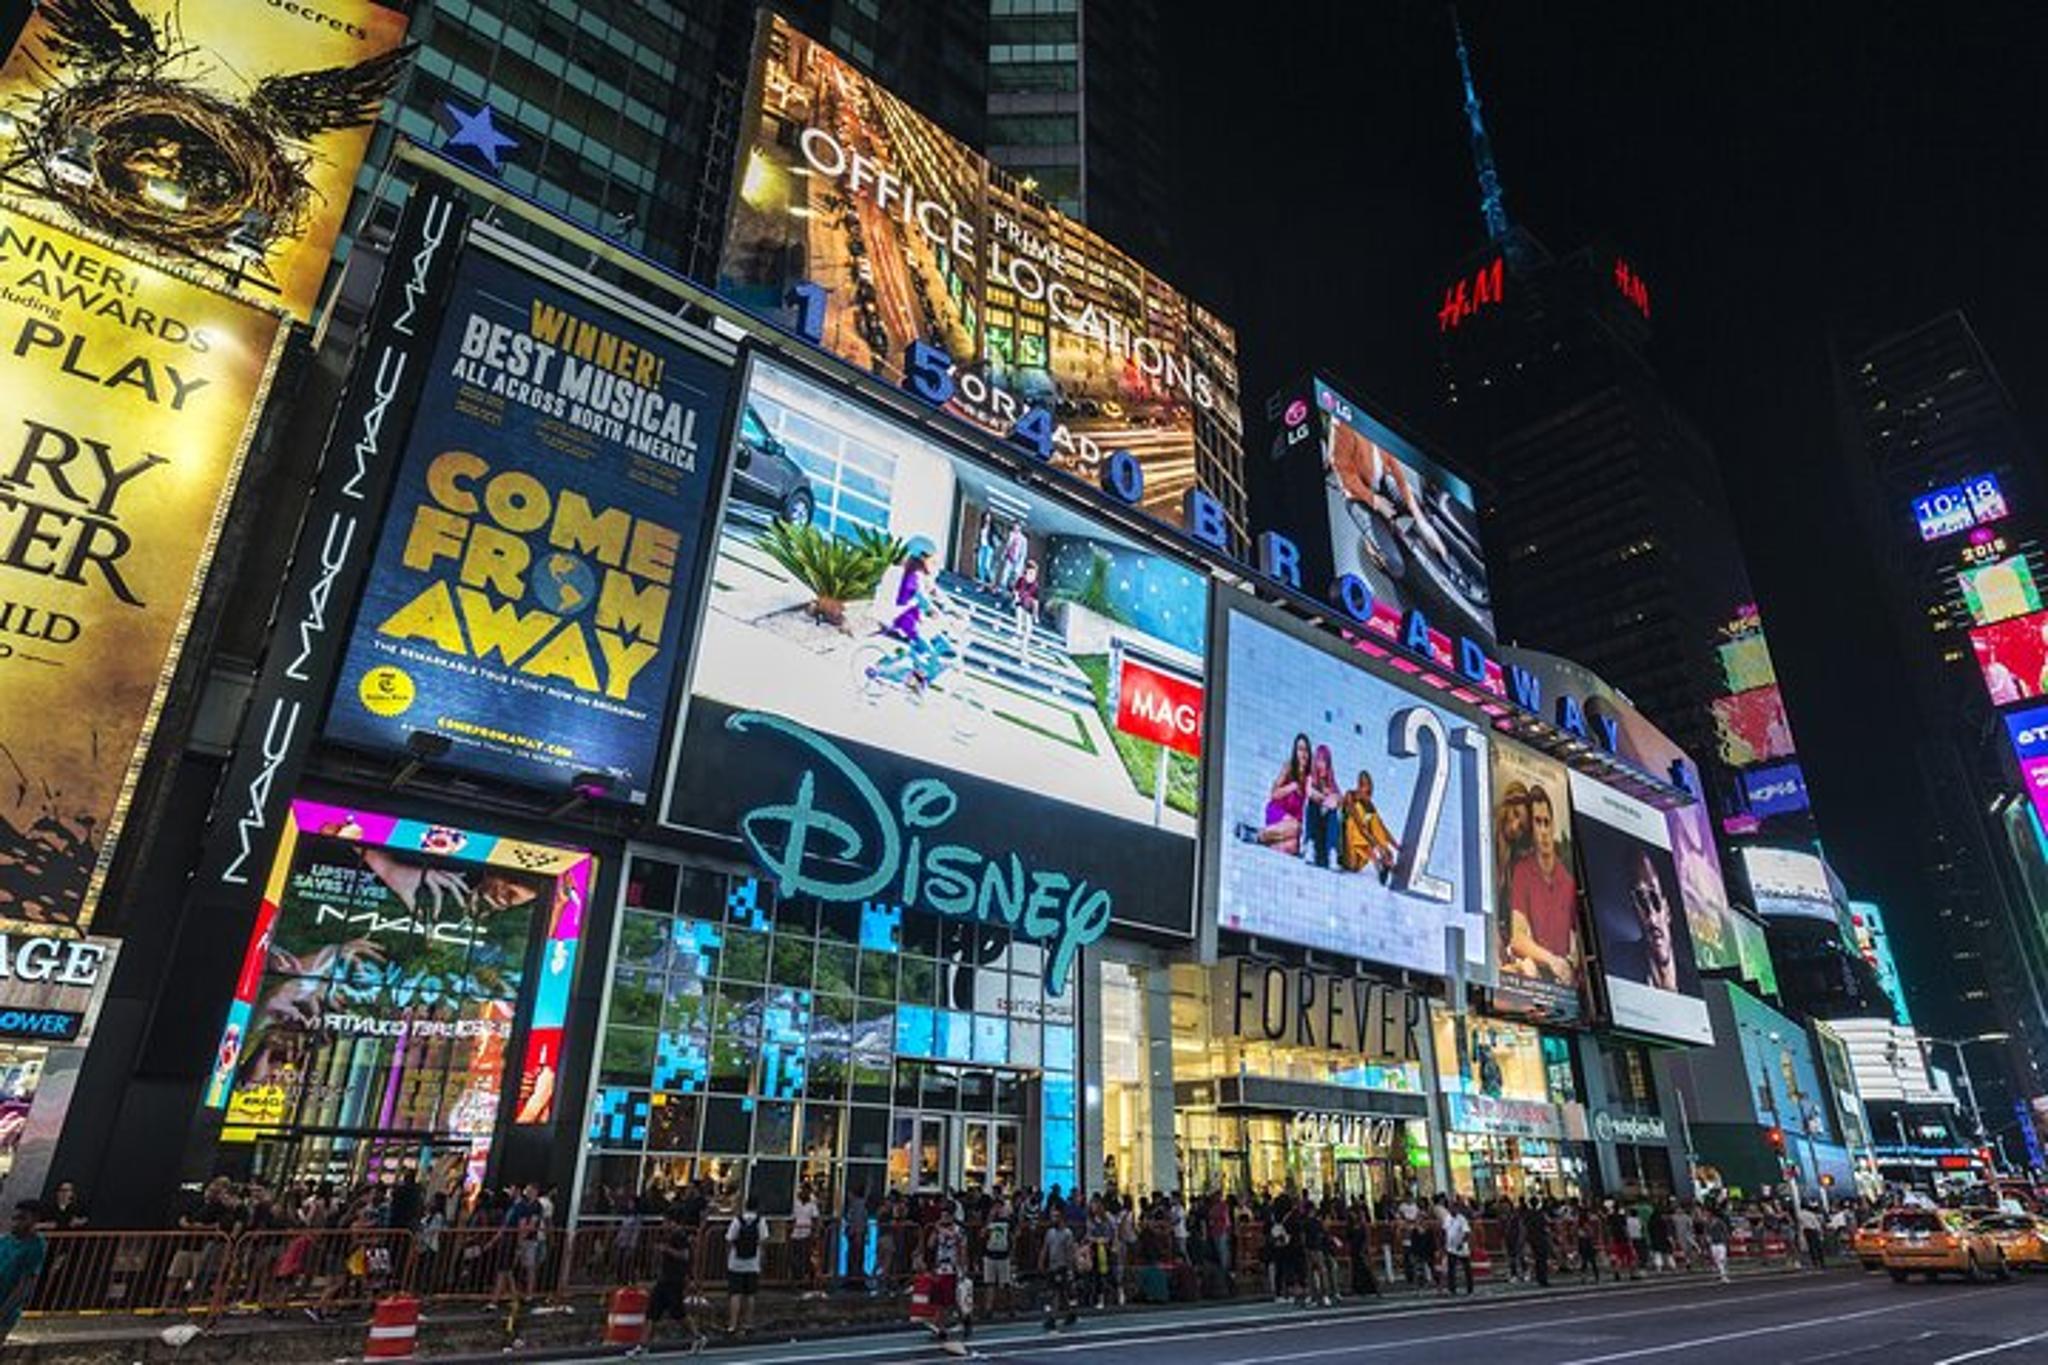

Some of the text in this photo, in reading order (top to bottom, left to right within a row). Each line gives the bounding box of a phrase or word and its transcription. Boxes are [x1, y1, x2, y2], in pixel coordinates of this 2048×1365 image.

[800, 127, 979, 266] OFFICE
[994, 212, 1067, 277] PRIME
[13, 317, 211, 411] PLAY
[17, 269, 210, 353] AWARDS
[530, 298, 665, 391] WINNER!
[990, 243, 1213, 408] LOCATIONS
[452, 357, 488, 389] ALL
[491, 374, 565, 418] ACROSS
[568, 403, 625, 443] NORTH
[624, 429, 696, 473] AMERICA
[460, 313, 556, 386] BEST
[557, 355, 698, 451] MUSICAL
[1287, 423, 1310, 445] LG
[1336, 400, 1353, 422] LG
[2, 419, 171, 521] RY
[426, 451, 682, 584] COME
[376, 580, 660, 700] AWAY
[1184, 486, 1618, 755] BROADWAY
[1131, 687, 1196, 736] MAG
[1388, 703, 1491, 914] 21
[1233, 956, 1421, 1062] FOREVER
